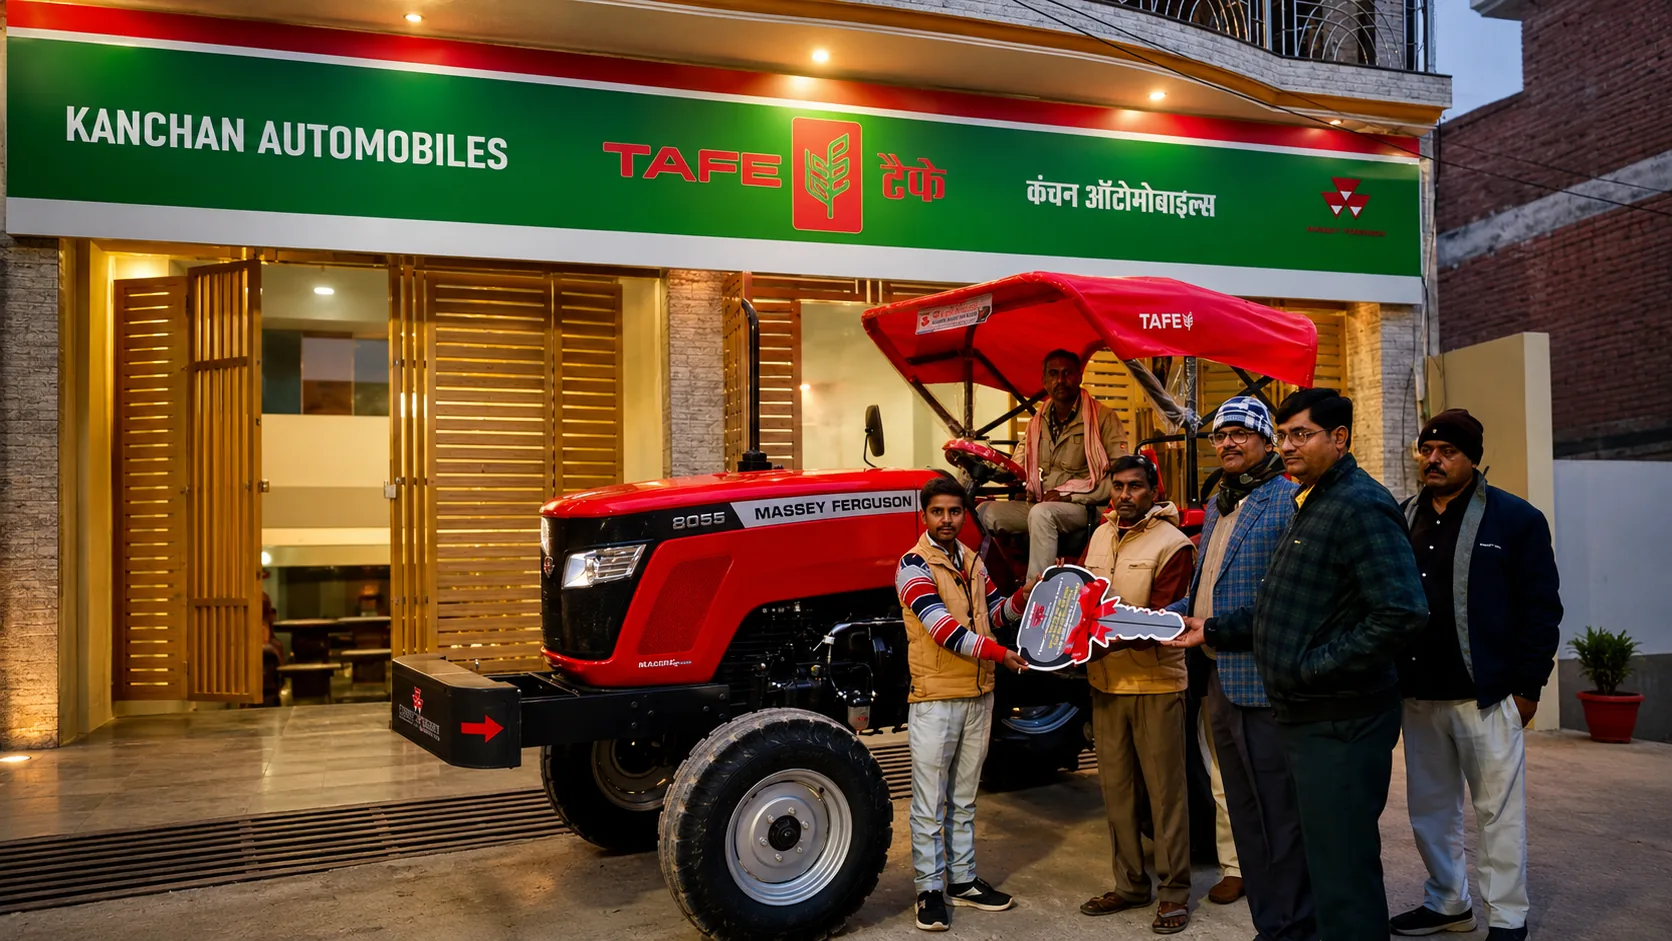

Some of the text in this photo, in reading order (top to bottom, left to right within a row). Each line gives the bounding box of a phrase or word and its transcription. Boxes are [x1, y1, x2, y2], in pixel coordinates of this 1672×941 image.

[66, 105, 508, 170] KANCHAN AUTOMOBILES
[603, 141, 782, 188] TAFE
[1026, 174, 1079, 208] कंचन
[1139, 313, 1182, 329] TAFE
[672, 511, 726, 530] 8055
[755, 496, 912, 520] MASSEY FERGUSON
